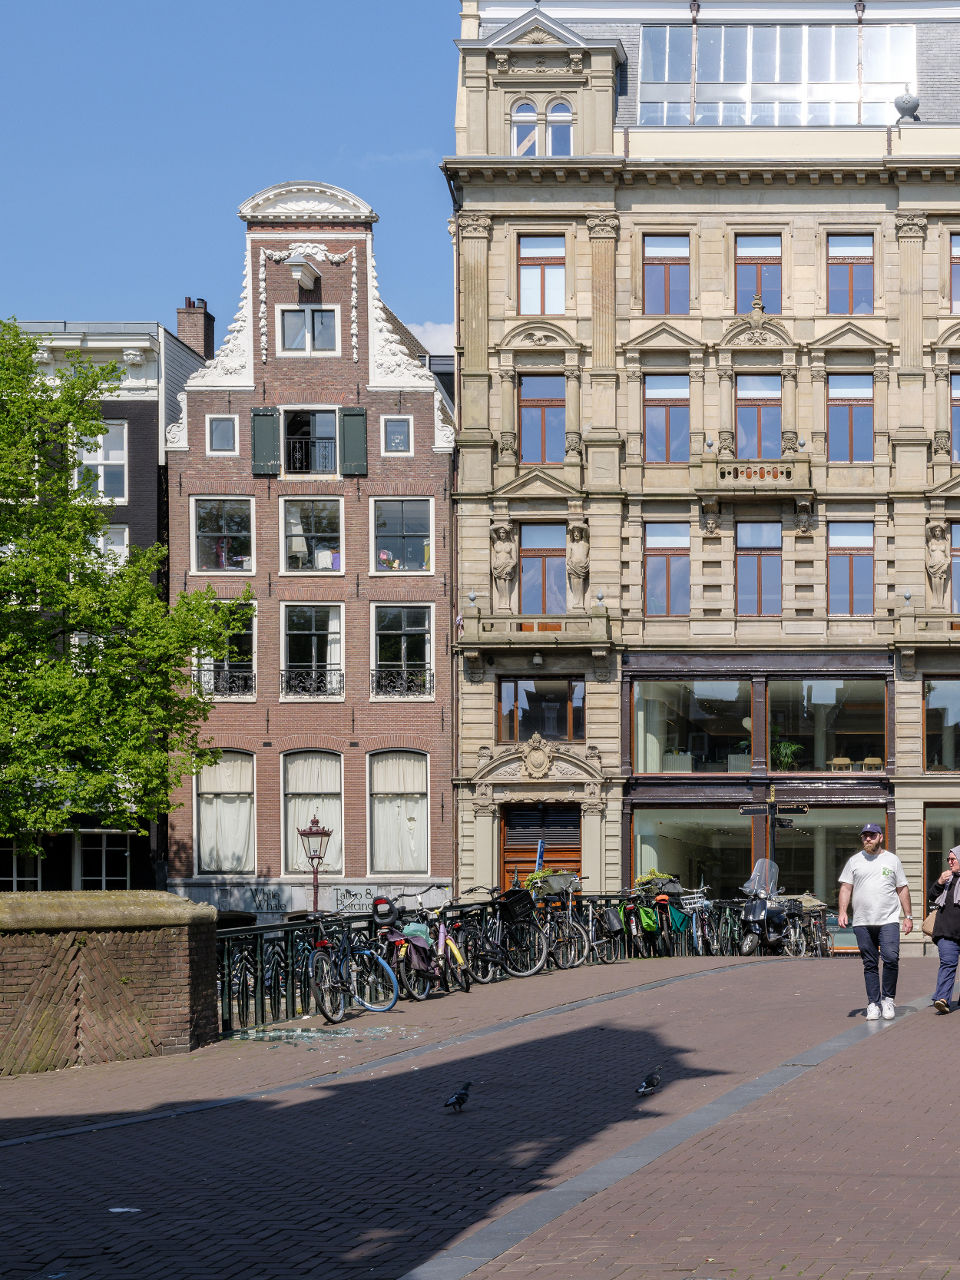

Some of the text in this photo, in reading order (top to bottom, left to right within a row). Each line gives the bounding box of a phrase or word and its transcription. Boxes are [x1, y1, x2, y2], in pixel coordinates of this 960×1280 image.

[250, 887, 280, 900] White
[365, 888, 374, 899] &
[255, 899, 287, 911] Whale
